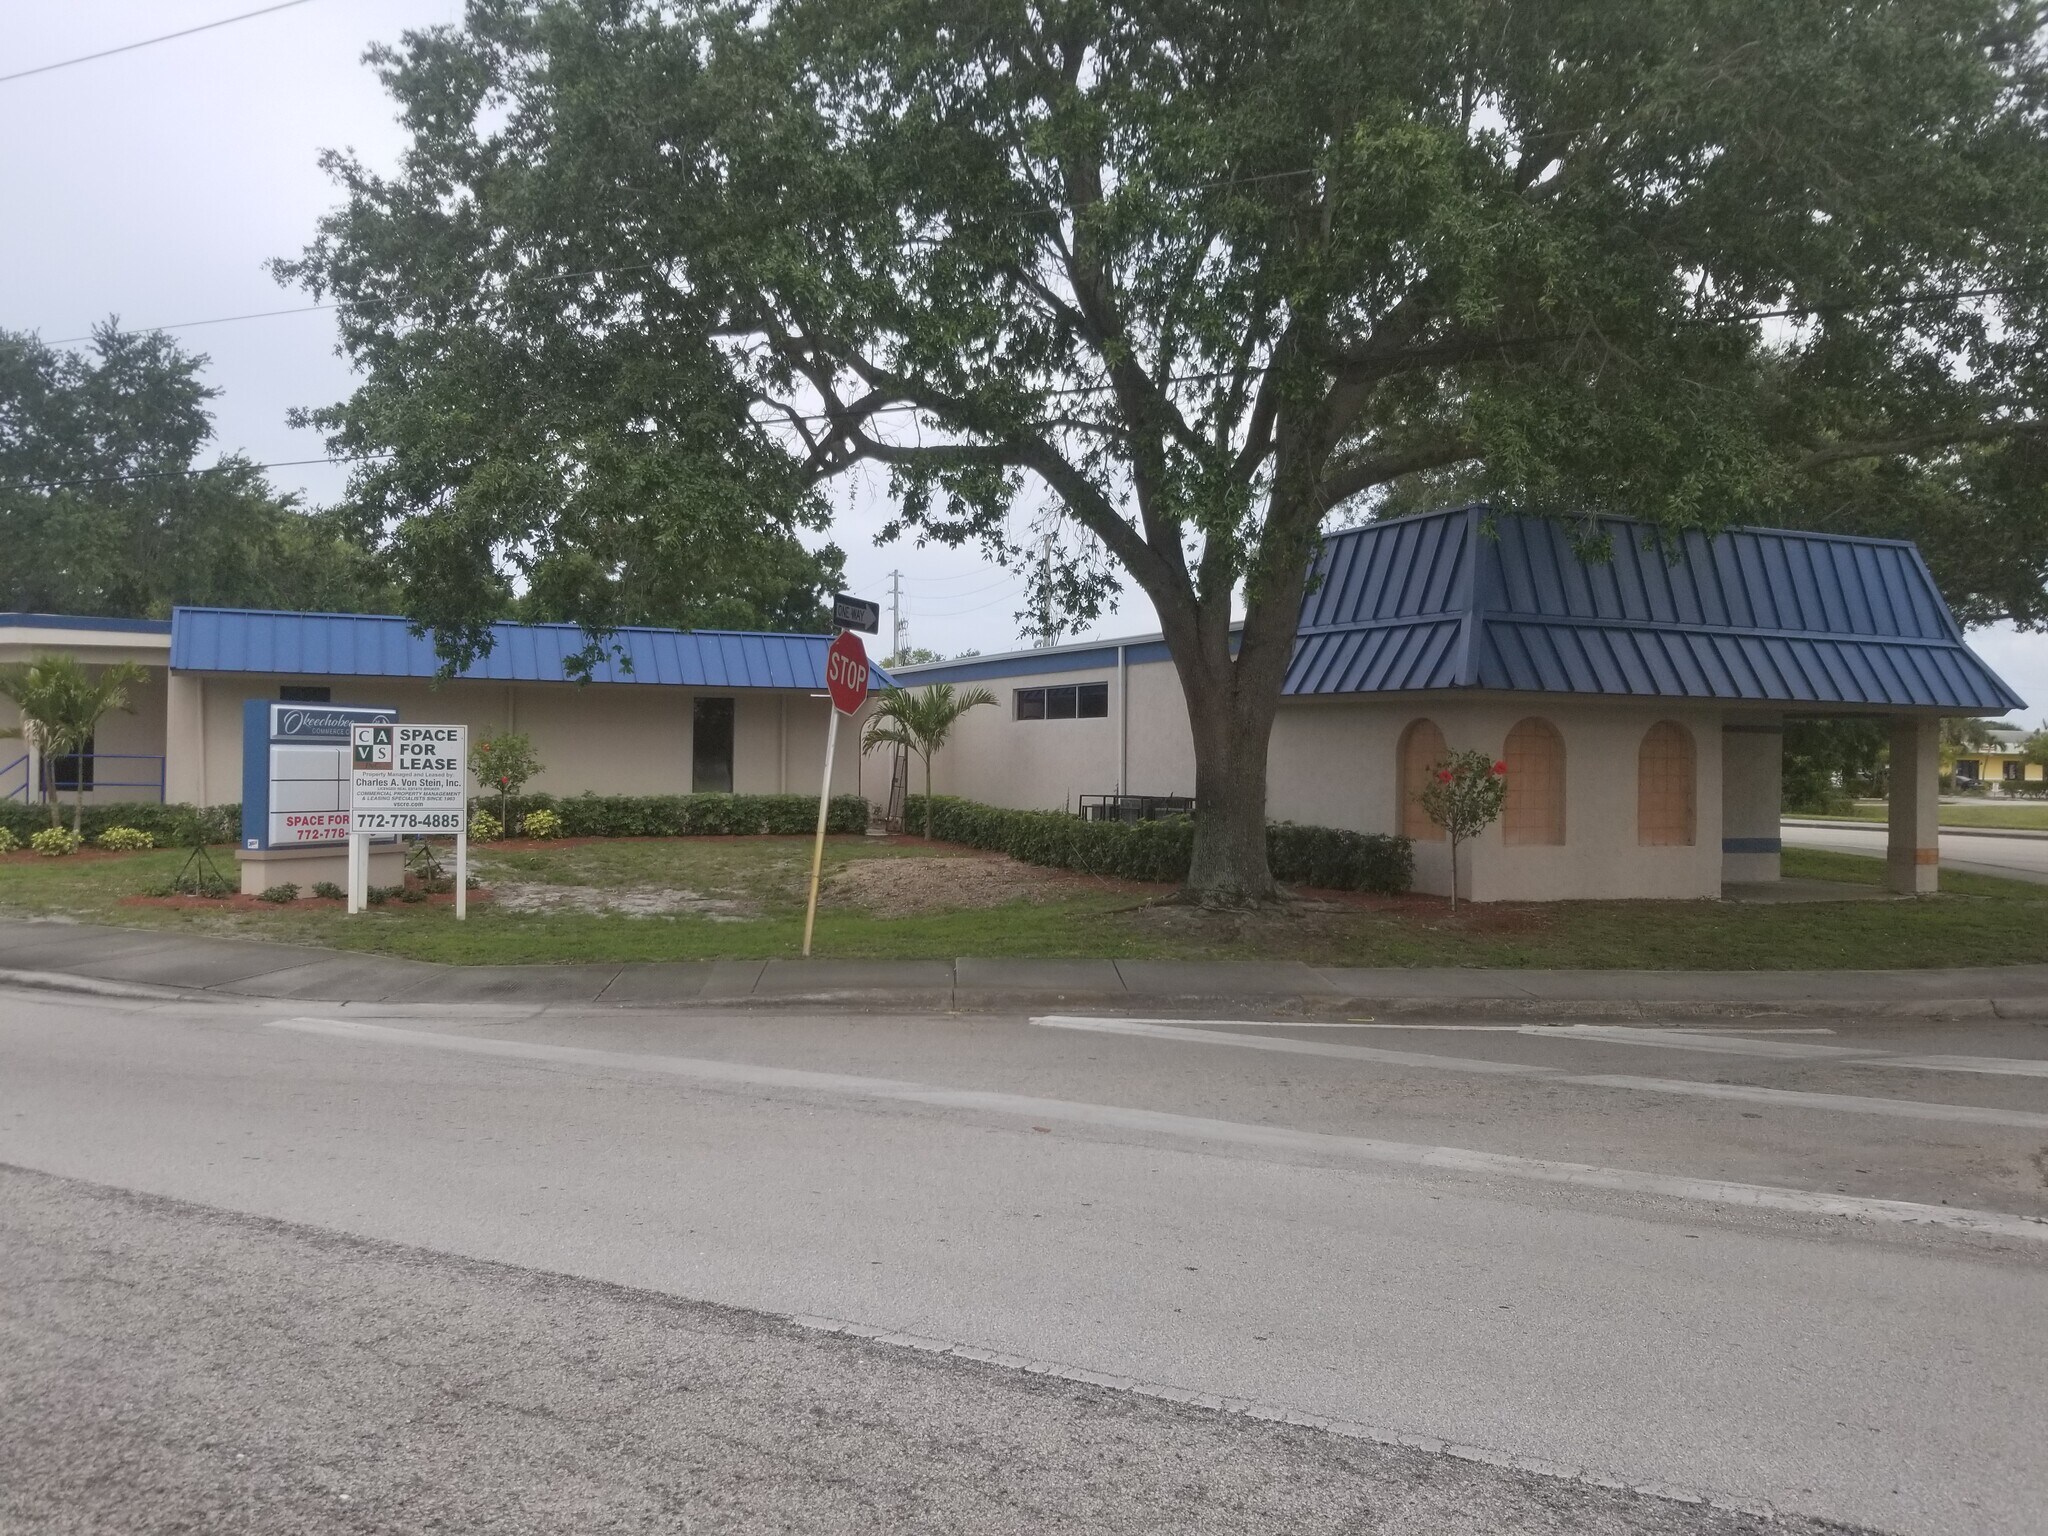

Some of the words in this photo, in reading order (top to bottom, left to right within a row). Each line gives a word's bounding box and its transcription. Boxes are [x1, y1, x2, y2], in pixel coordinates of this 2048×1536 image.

[836, 604, 850, 619] ONE
[851, 608, 865, 622] WAY
[829, 652, 866, 692] STOP
[312, 727, 344, 735] COMMERCE
[400, 729, 457, 741] SPACE
[400, 744, 436, 755] FOR
[400, 758, 457, 770] LEASE
[356, 778, 388, 787] Charles
[391, 779, 399, 787] A.
[401, 779, 417, 787] Von
[420, 779, 444, 788] Stein,
[446, 779, 461, 787] Inc.
[286, 816, 324, 827] SPACE
[328, 815, 350, 825] FOR
[357, 814, 459, 827] 772-778-4885
[297, 828, 349, 840] 772-778-
